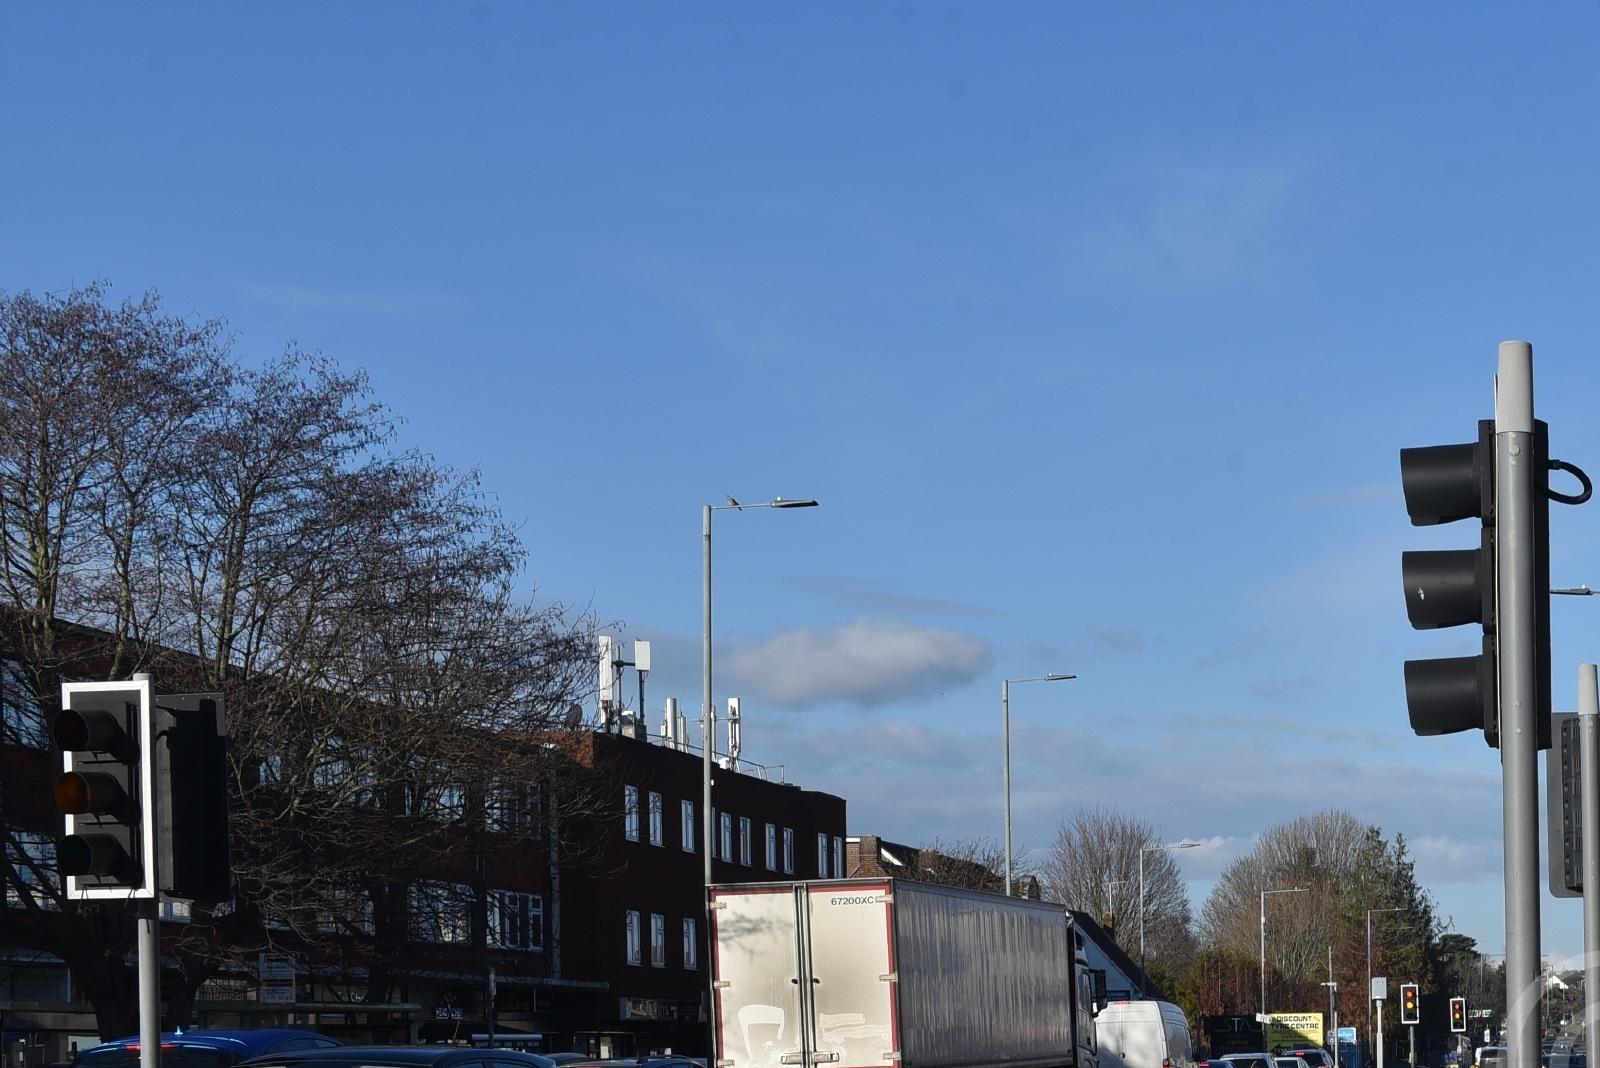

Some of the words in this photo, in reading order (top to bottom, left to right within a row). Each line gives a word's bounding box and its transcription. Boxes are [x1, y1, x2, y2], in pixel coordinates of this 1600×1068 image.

[831, 896, 874, 905] 67200XC
[1276, 1015, 1312, 1023] DISCOUNT
[1291, 1022, 1319, 1030] CENTRE
